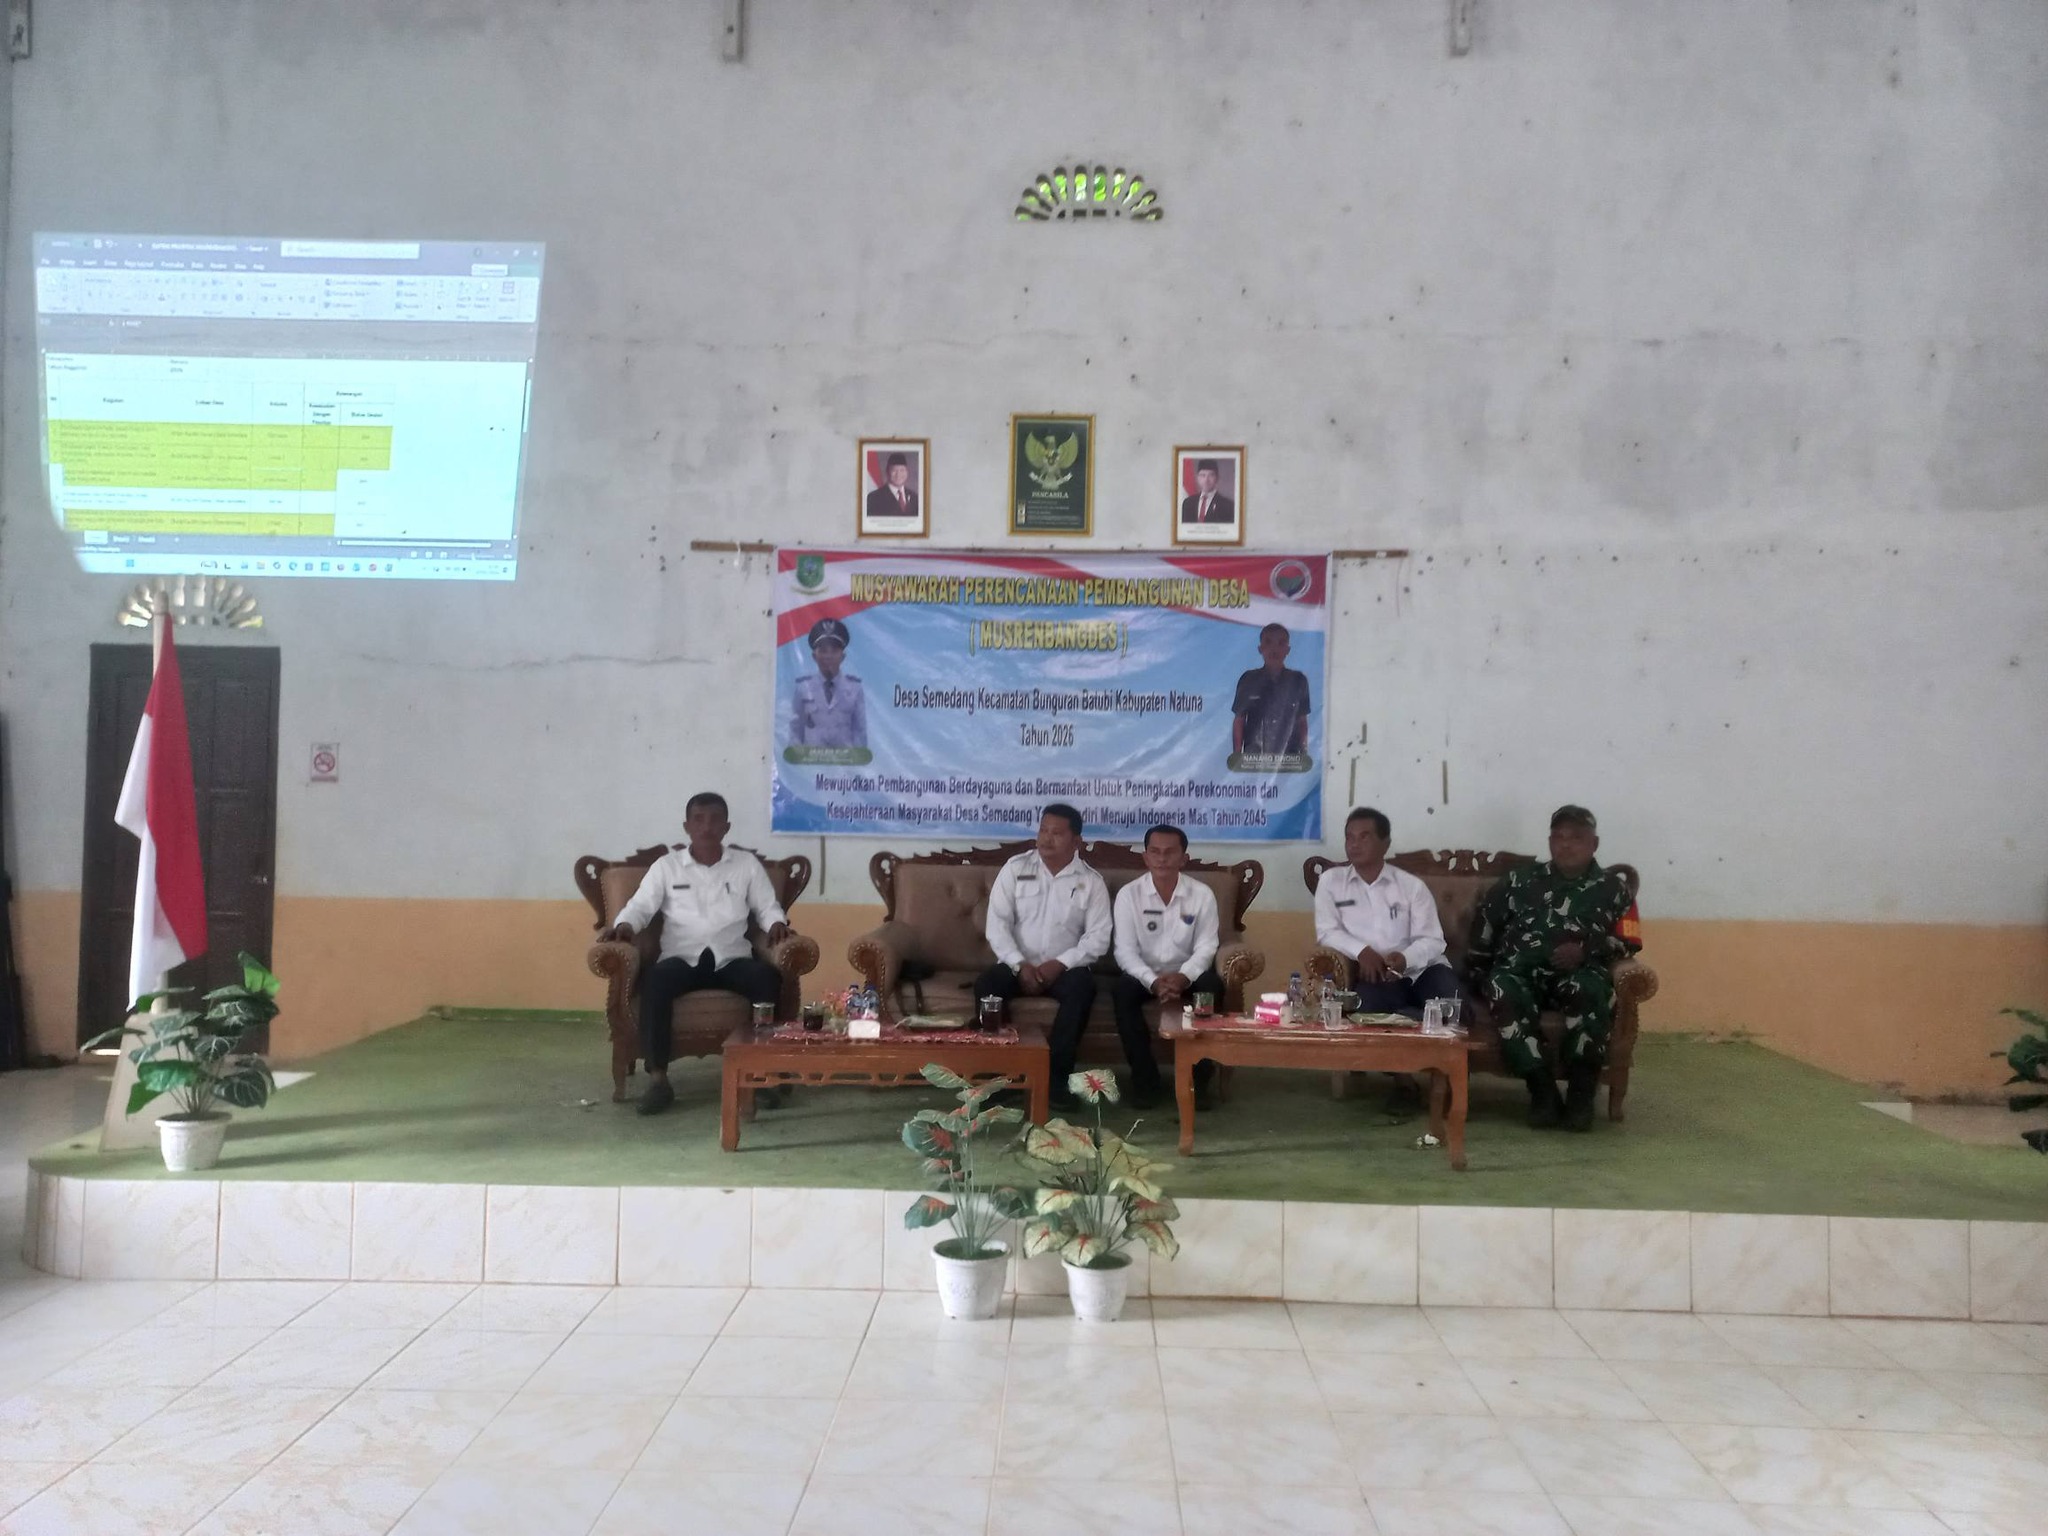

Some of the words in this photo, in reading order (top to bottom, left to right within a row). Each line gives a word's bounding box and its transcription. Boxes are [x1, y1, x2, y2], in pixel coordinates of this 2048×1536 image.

[851, 573, 960, 603] MUSYAWARAH
[964, 576, 1079, 606] PERENCANAAN
[1084, 577, 1204, 607] PEMBANGUNAN
[1208, 577, 1250, 608] DESA
[979, 620, 1118, 651] MUSRENBANGDES
[894, 683, 919, 708] Desa
[922, 684, 974, 715] Semedang
[978, 687, 1030, 710] Kecamatan
[1032, 688, 1079, 717] Bunguran
[1082, 688, 1113, 711] Batubi
[1115, 689, 1166, 717] Kabupaten
[1169, 690, 1203, 713] Natuna
[1020, 723, 1049, 746] Tahun
[1051, 724, 1074, 747] 2026
[815, 773, 875, 795] Mewujudkan
[877, 774, 946, 797] Pembangunan
[949, 776, 1012, 799] Berdayaguna
[1015, 777, 1033, 796] dan
[1035, 778, 1091, 796] Bermanfaat
[1094, 778, 1122, 797] Untuk
[1125, 780, 1185, 802] Peningkatan
[1188, 780, 1257, 799] Perekonomian
[1260, 781, 1278, 799] dan
[827, 801, 895, 822] Kesejahteraan
[898, 803, 952, 825] Masyarakat
[955, 804, 979, 821] Desa
[981, 804, 1032, 826] Semedang
[1101, 807, 1135, 828] Menuju
[1138, 807, 1186, 826] Indonesia
[1188, 808, 1208, 826] Mas
[1211, 808, 1240, 826] Tahun
[1243, 809, 1267, 827] 2045
